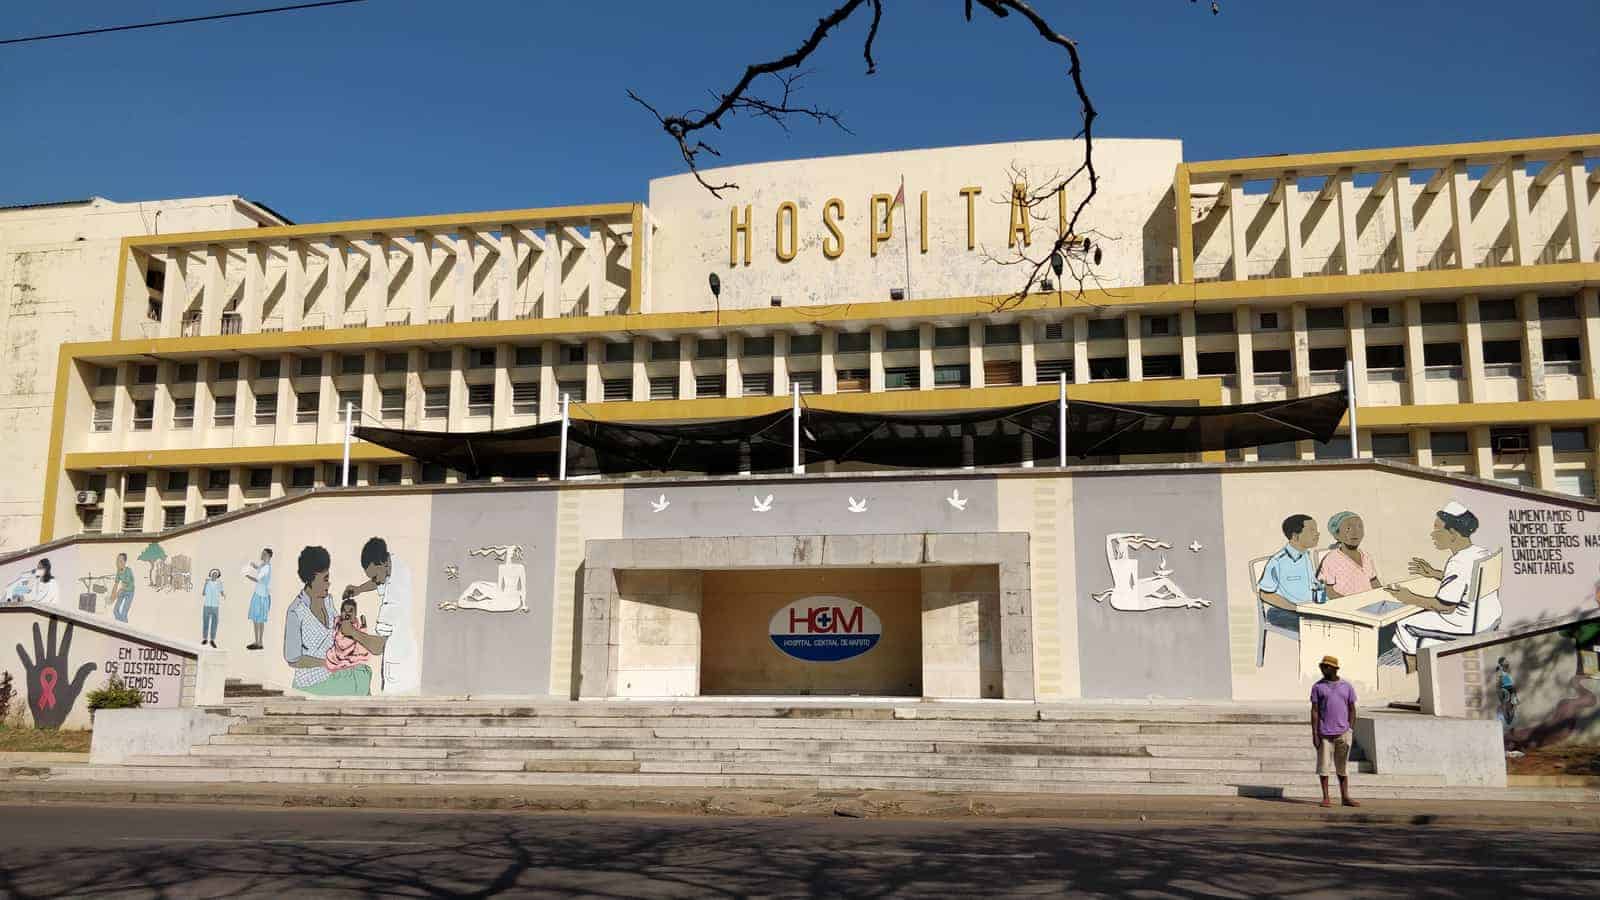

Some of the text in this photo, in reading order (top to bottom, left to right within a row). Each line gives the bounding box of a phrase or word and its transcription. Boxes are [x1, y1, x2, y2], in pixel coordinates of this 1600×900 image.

[730, 182, 1084, 268] HOSPITAL
[1509, 509, 1585, 522] AUMENTAMOS O
[1553, 523, 1567, 535] DE
[1511, 535, 1580, 548] ENFERMEIROS
[1512, 549, 1562, 561] UNIDADES
[789, 606, 864, 633] HCM
[783, 639, 812, 648] HOSPITAL
[813, 639, 839, 648] CENTRAL
[118, 647, 169, 661] EM TODOS
[105, 661, 181, 676] OS DISTRITOS
[123, 676, 154, 689] TEMOS
